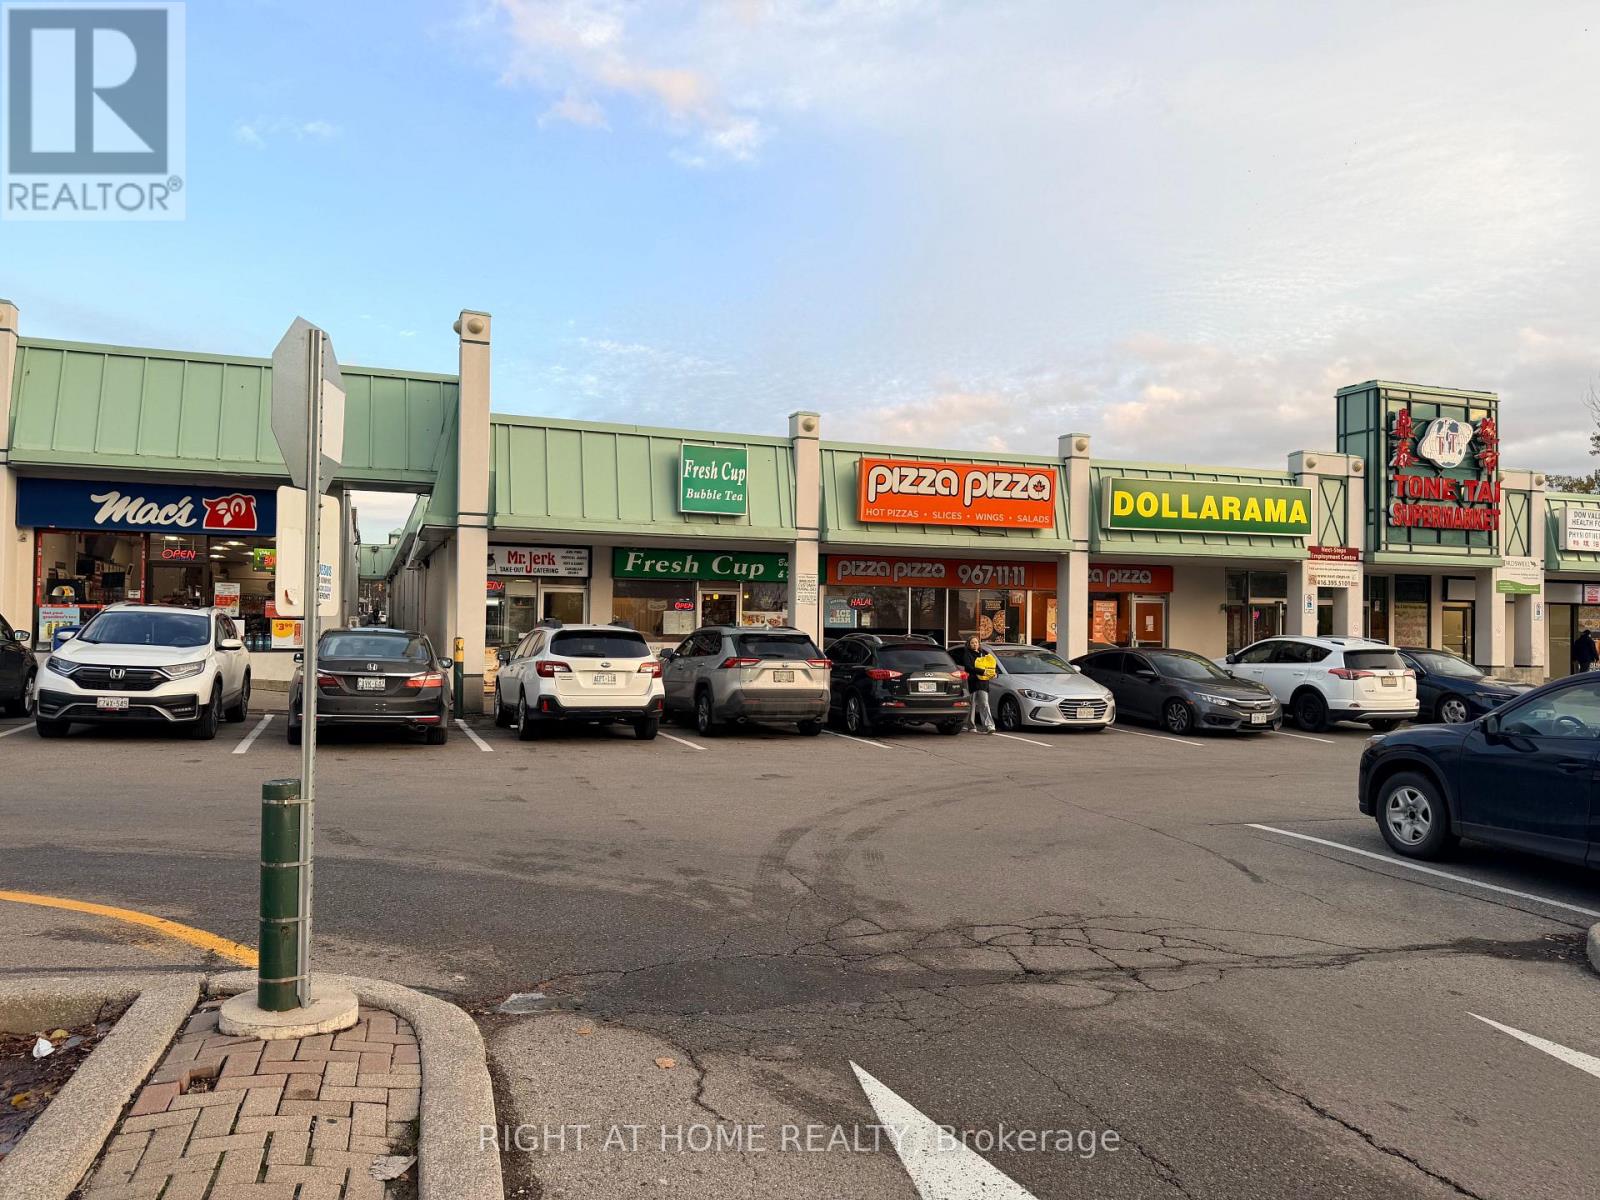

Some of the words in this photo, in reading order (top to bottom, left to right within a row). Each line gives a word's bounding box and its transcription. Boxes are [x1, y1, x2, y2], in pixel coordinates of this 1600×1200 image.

[683, 459, 718, 479] Fresh
[721, 462, 746, 486] Cup
[686, 488, 722, 500] Bubble
[724, 490, 744, 501] Tea
[867, 465, 959, 503] pizza
[963, 470, 1051, 507] pizza
[1392, 474, 1457, 500] TONE
[1464, 479, 1500, 503] TAI
[90, 490, 197, 528] Mac's
[866, 508, 886, 517] HOT
[887, 509, 919, 518] PIZZAS
[932, 511, 962, 520] SLICES
[975, 513, 1004, 522] WINGS
[1017, 515, 1049, 523] SALADS
[1113, 490, 1308, 524] DOLLARAMA
[1393, 502, 1501, 531] SUPERMARKET
[1572, 519, 1593, 527] HEALTH
[161, 549, 196, 560] OPEN
[507, 551, 526, 565] Mr.
[525, 552, 556, 574] Jerk
[624, 552, 699, 574] Fresh
[712, 555, 765, 578] Cup
[1311, 553, 1340, 561] Employment
[500, 566, 524, 574] TAKE-OUT
[533, 567, 559, 575] CATERING
[837, 560, 891, 581] pizza
[893, 562, 945, 583] pizza
[1106, 568, 1152, 588] pizza
[675, 602, 694, 610] OPEN
[850, 598, 873, 606] HALAL
